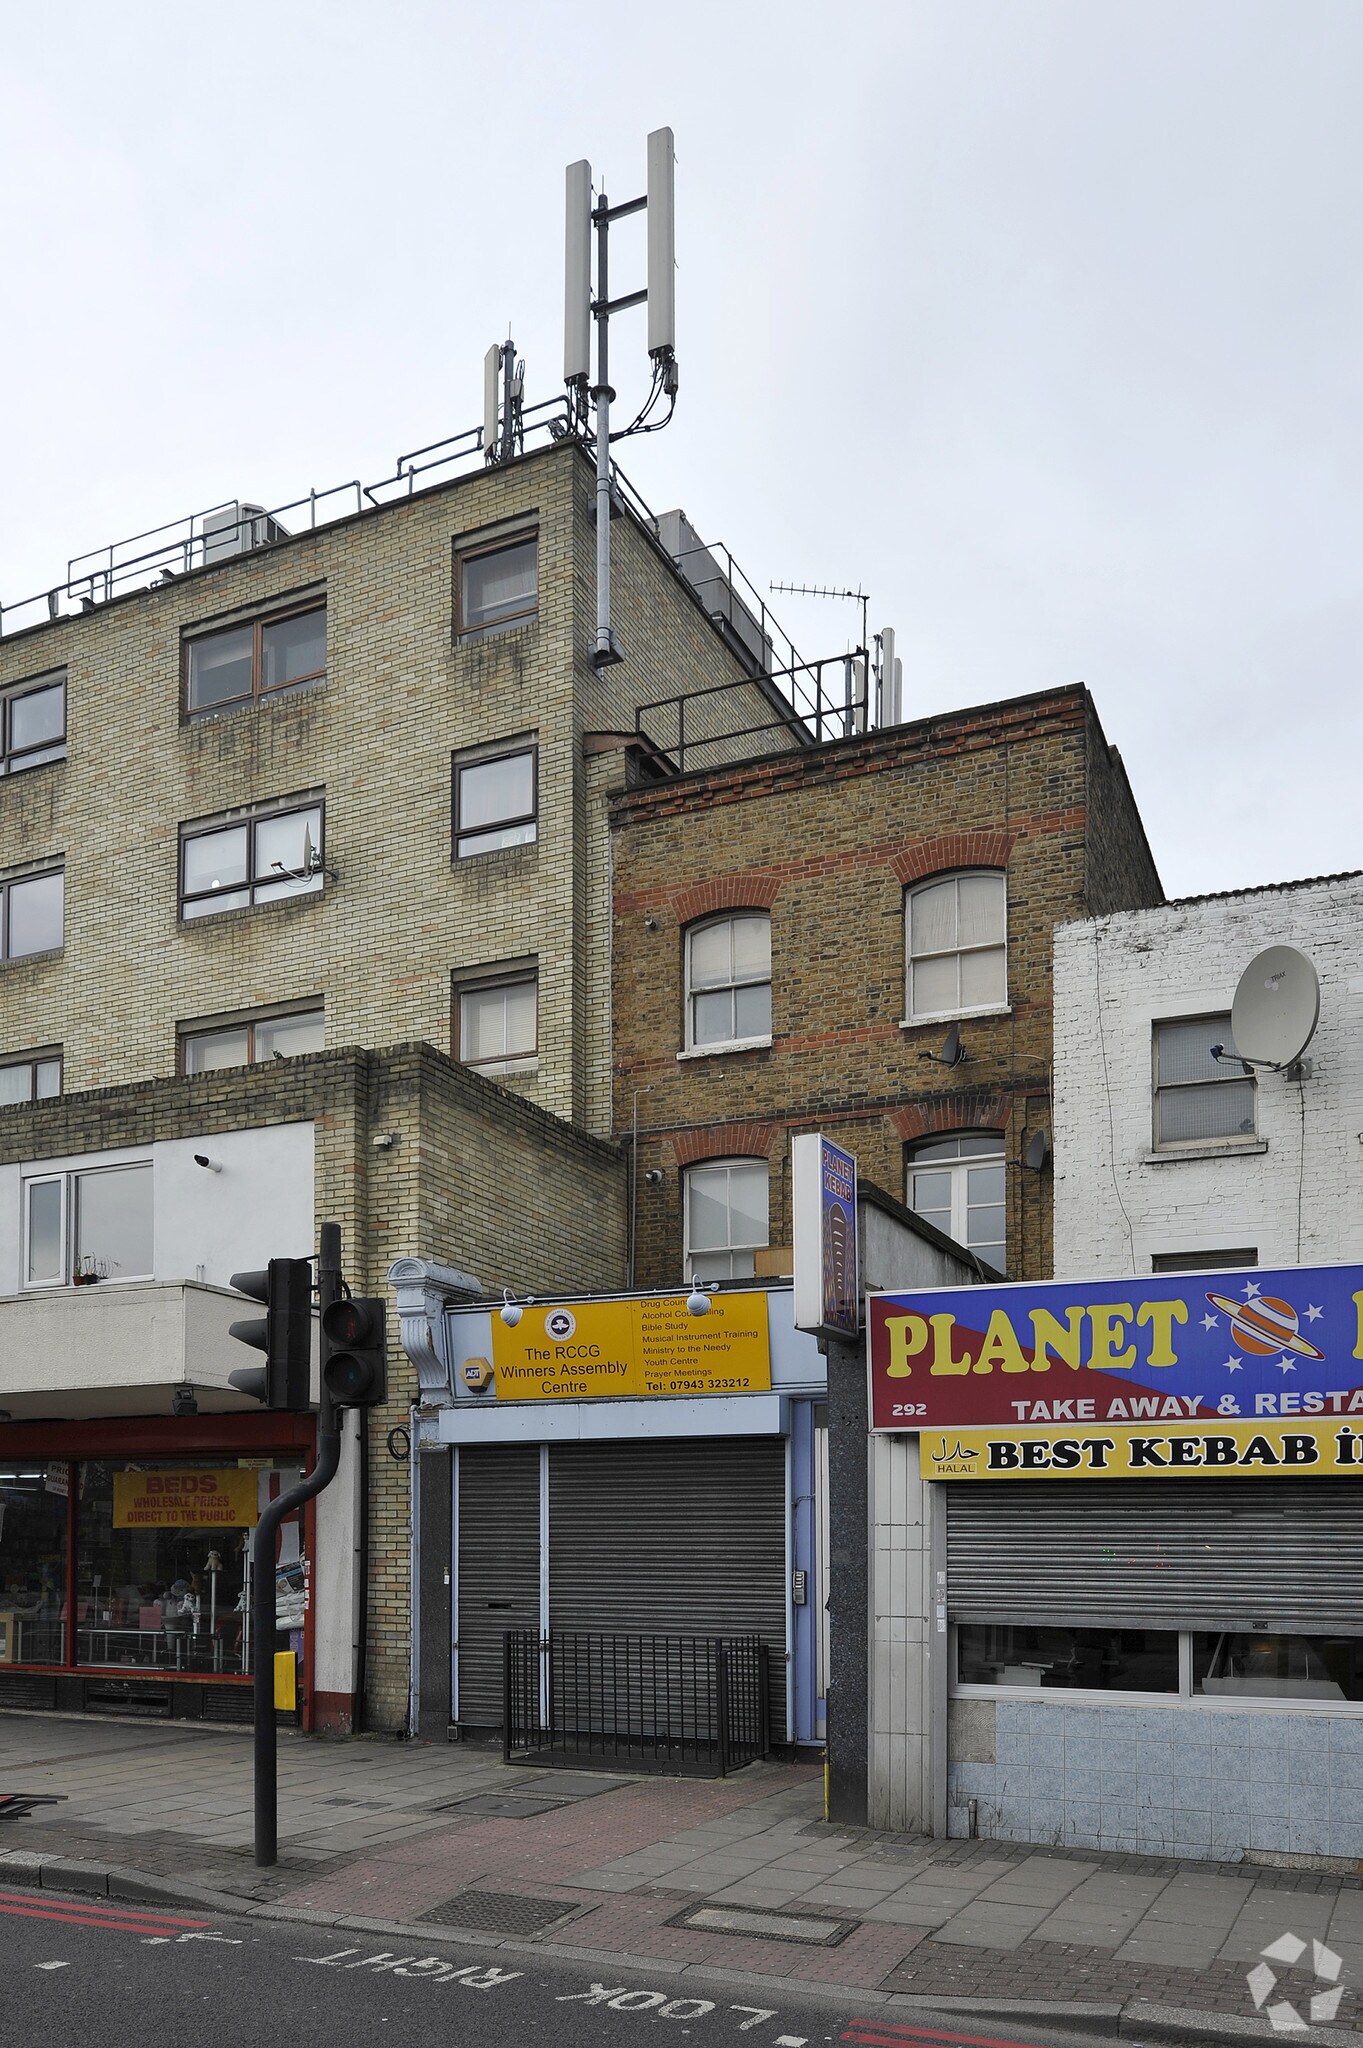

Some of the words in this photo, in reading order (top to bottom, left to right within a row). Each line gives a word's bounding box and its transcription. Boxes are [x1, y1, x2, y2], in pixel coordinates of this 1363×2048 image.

[822, 1147, 853, 1184] PLANET
[824, 1170, 852, 1203] KEBAB
[640, 1300, 661, 1309] Drug
[641, 1310, 673, 1320] Alcohol
[641, 1323, 663, 1332] Bible
[664, 1322, 689, 1331] Study
[642, 1335, 674, 1343] Musical
[676, 1332, 721, 1341] Instrument
[723, 1330, 759, 1339] Training
[884, 1299, 1189, 1378] PLANET
[524, 1347, 551, 1361] The
[555, 1344, 600, 1359] RCCG
[643, 1347, 675, 1355] Ministry
[687, 1345, 701, 1353] the
[703, 1343, 731, 1352] Needy
[644, 1359, 668, 1367] Youth
[670, 1357, 699, 1366] Centre
[466, 1369, 479, 1377] ADT
[500, 1365, 556, 1379] Winners
[560, 1360, 628, 1377] Assembly
[644, 1370, 672, 1379] Prayer
[673, 1368, 713, 1377] Meetings
[541, 1381, 588, 1394] Centre
[645, 1381, 666, 1391] Tel:
[670, 1380, 704, 1390] 07943
[708, 1378, 750, 1389] 323212
[891, 1403, 928, 1416] 292
[1011, 1398, 1096, 1421] TAKE
[1106, 1395, 1204, 1419] AWAY
[1216, 1394, 1242, 1416] &
[987, 1436, 1115, 1470] BEST
[1127, 1433, 1320, 1469] KEBAB
[937, 1464, 975, 1473] HALAL
[146, 1474, 218, 1494] BEDS
[133, 1496, 191, 1508] WHOLESALE
[193, 1496, 229, 1508] PRICES
[127, 1510, 162, 1522] DIRECT
[166, 1510, 178, 1522] TO
[180, 1510, 197, 1521] THE
[200, 1509, 236, 1521] PUBLIC
[292, 1948, 525, 1989] RIGHT
[555, 1982, 779, 2031] LOOK
